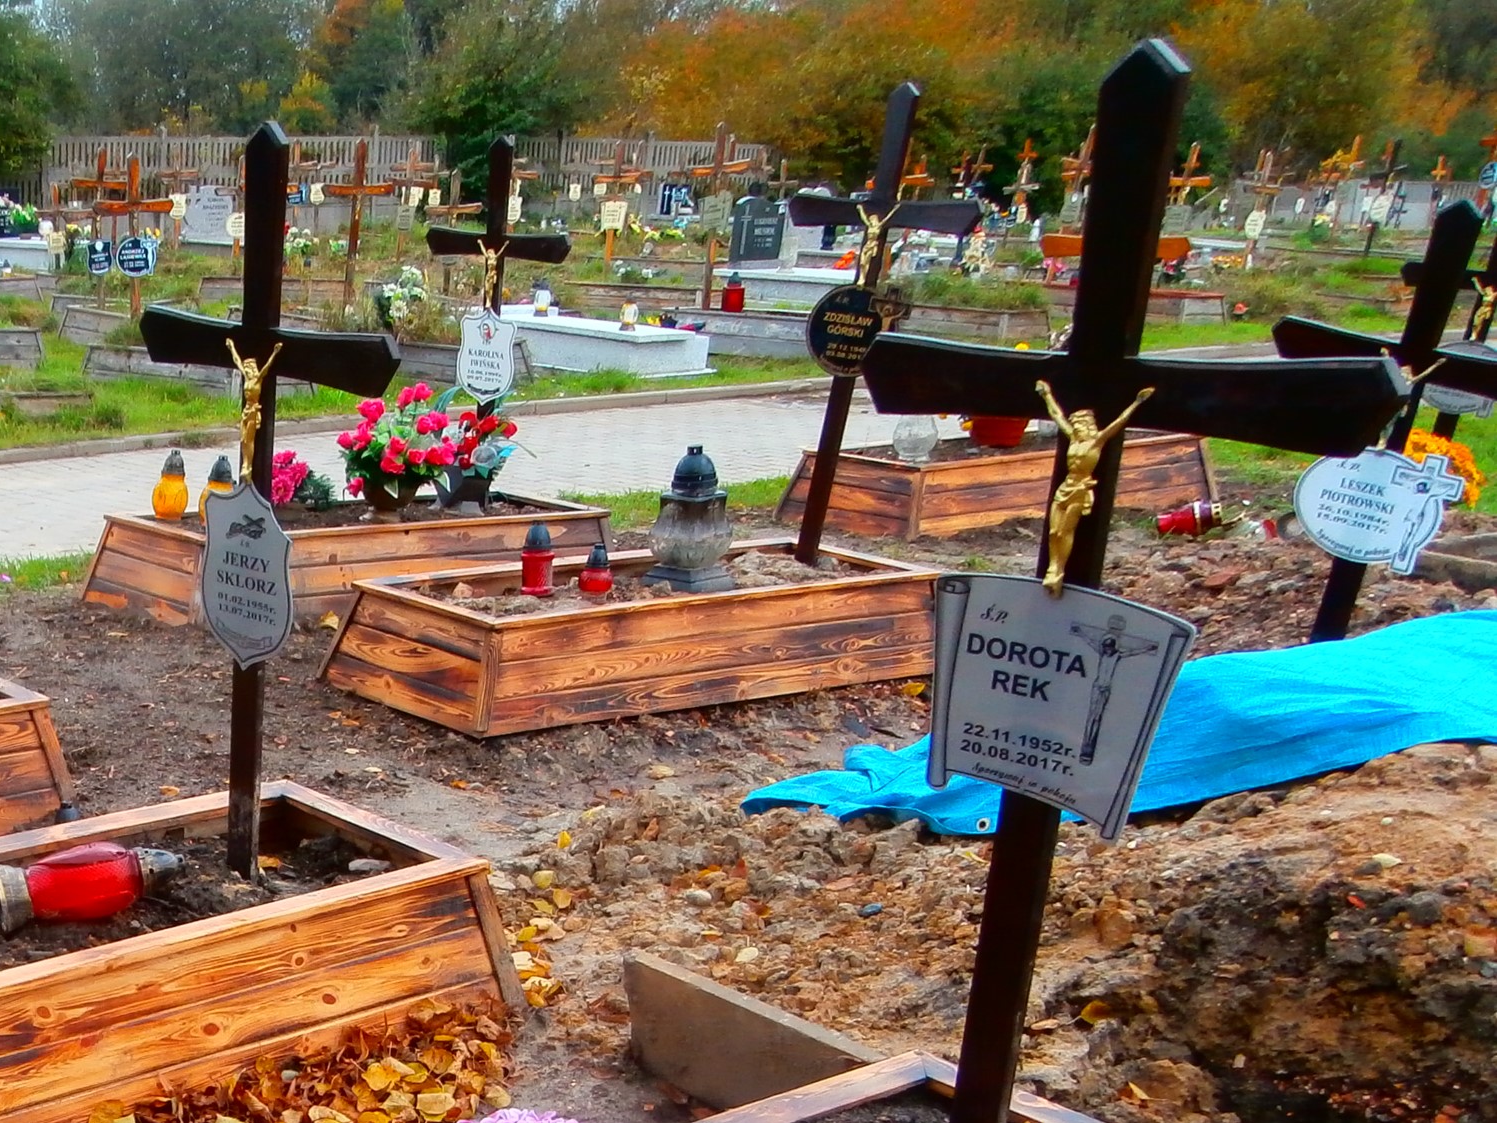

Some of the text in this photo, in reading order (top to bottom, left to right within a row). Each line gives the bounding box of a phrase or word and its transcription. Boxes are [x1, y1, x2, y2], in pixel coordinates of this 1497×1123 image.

[823, 312, 873, 327] ZDZISŁAW
[827, 324, 864, 338] GÓRSKI
[468, 348, 504, 361] KAROLINA
[470, 359, 500, 371] IWIŃSKA
[1339, 477, 1386, 498] LESZEK
[1319, 488, 1395, 516] PIOTROWSKI
[222, 550, 270, 573] JERZY
[216, 570, 277, 596] SKLORZ
[217, 591, 277, 615] 01.02.1955r.
[966, 632, 1087, 678] DOROTA
[991, 670, 1051, 702] REK
[963, 722, 1076, 758] 22.11.1952r.
[960, 739, 1075, 777] 20.08.2017r.
